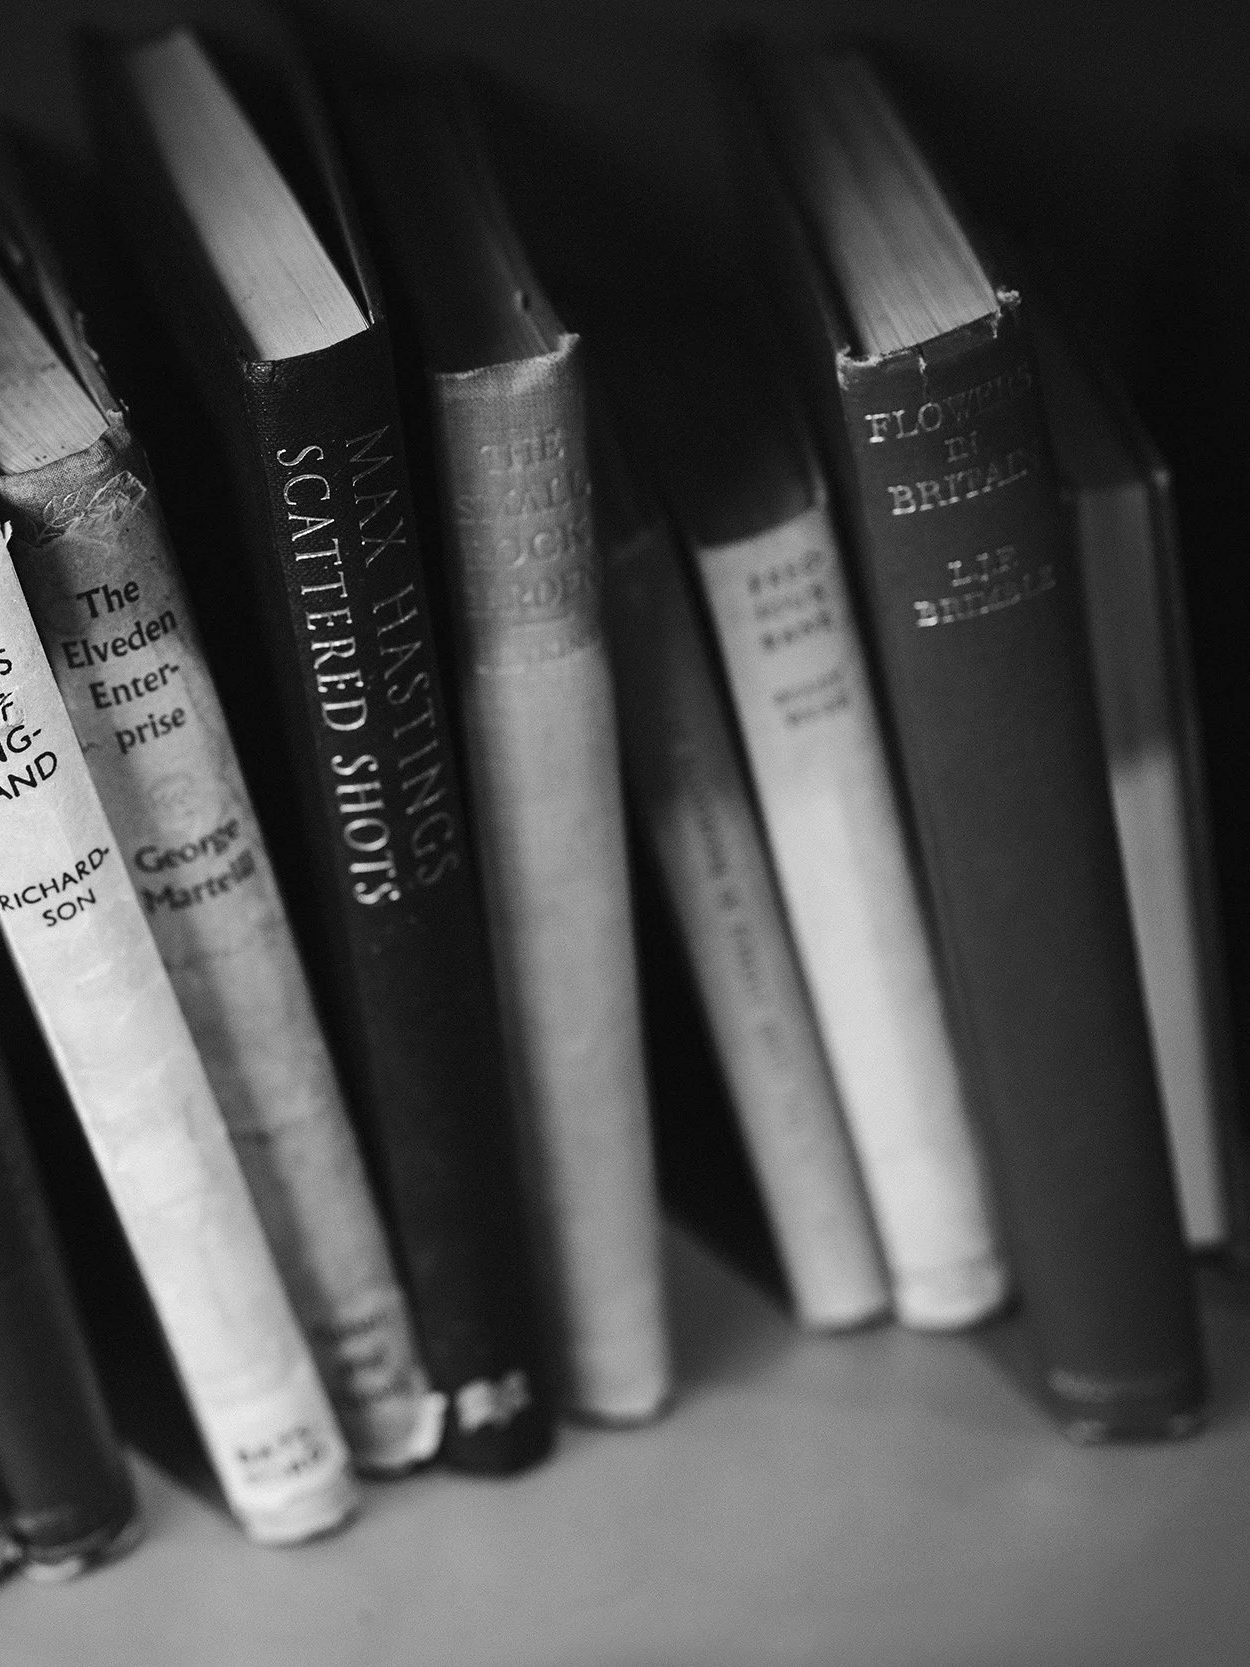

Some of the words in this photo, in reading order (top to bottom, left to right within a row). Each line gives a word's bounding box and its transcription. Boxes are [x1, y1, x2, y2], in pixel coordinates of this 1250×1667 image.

[346, 425, 407, 568] MAX
[76, 580, 141, 619] The
[61, 610, 177, 669] Elveden
[88, 663, 180, 711] Enter-
[276, 445, 368, 732] SCATTERED
[331, 754, 401, 905] SHOTS
[115, 706, 186, 756] prise
[372, 584, 460, 884] HASTINGS
[134, 818, 239, 874] George
[42, 888, 97, 928] SON
